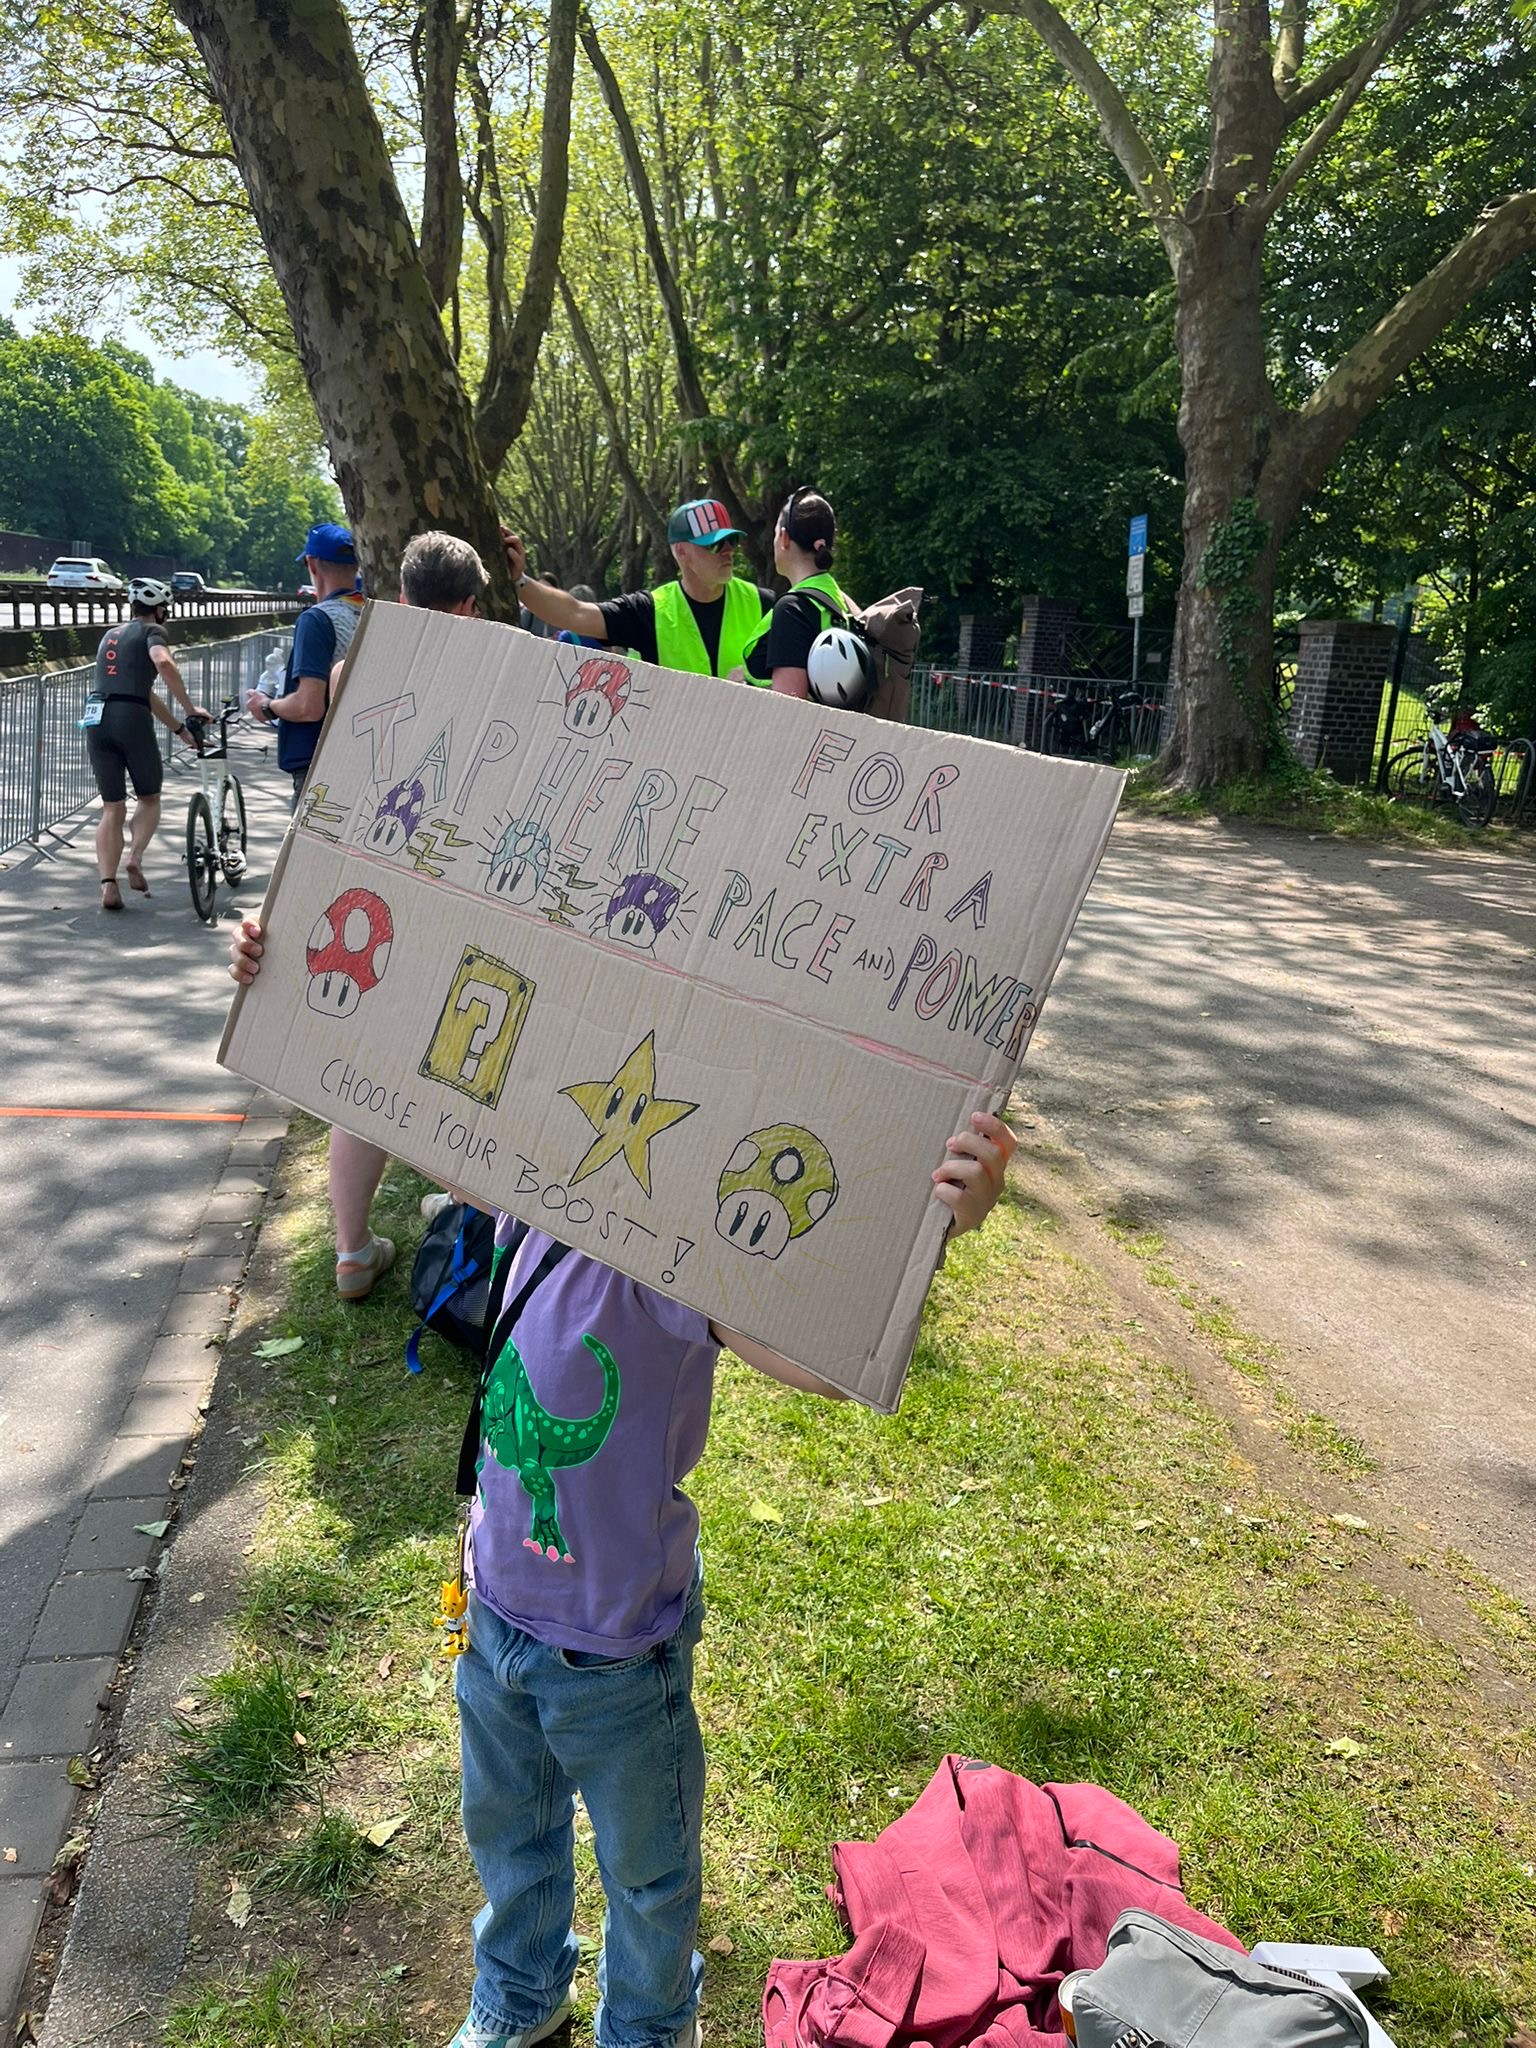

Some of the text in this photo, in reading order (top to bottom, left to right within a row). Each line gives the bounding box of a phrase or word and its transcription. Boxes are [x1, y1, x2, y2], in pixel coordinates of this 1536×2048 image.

[352, 692, 728, 893] TAP HERE
[791, 729, 960, 834] FOR
[786, 813, 993, 930] EXTRA
[708, 869, 1037, 1061] PACE AND POWER
[320, 1058, 417, 1129] CHOOSE
[432, 1111, 498, 1170] YOUR
